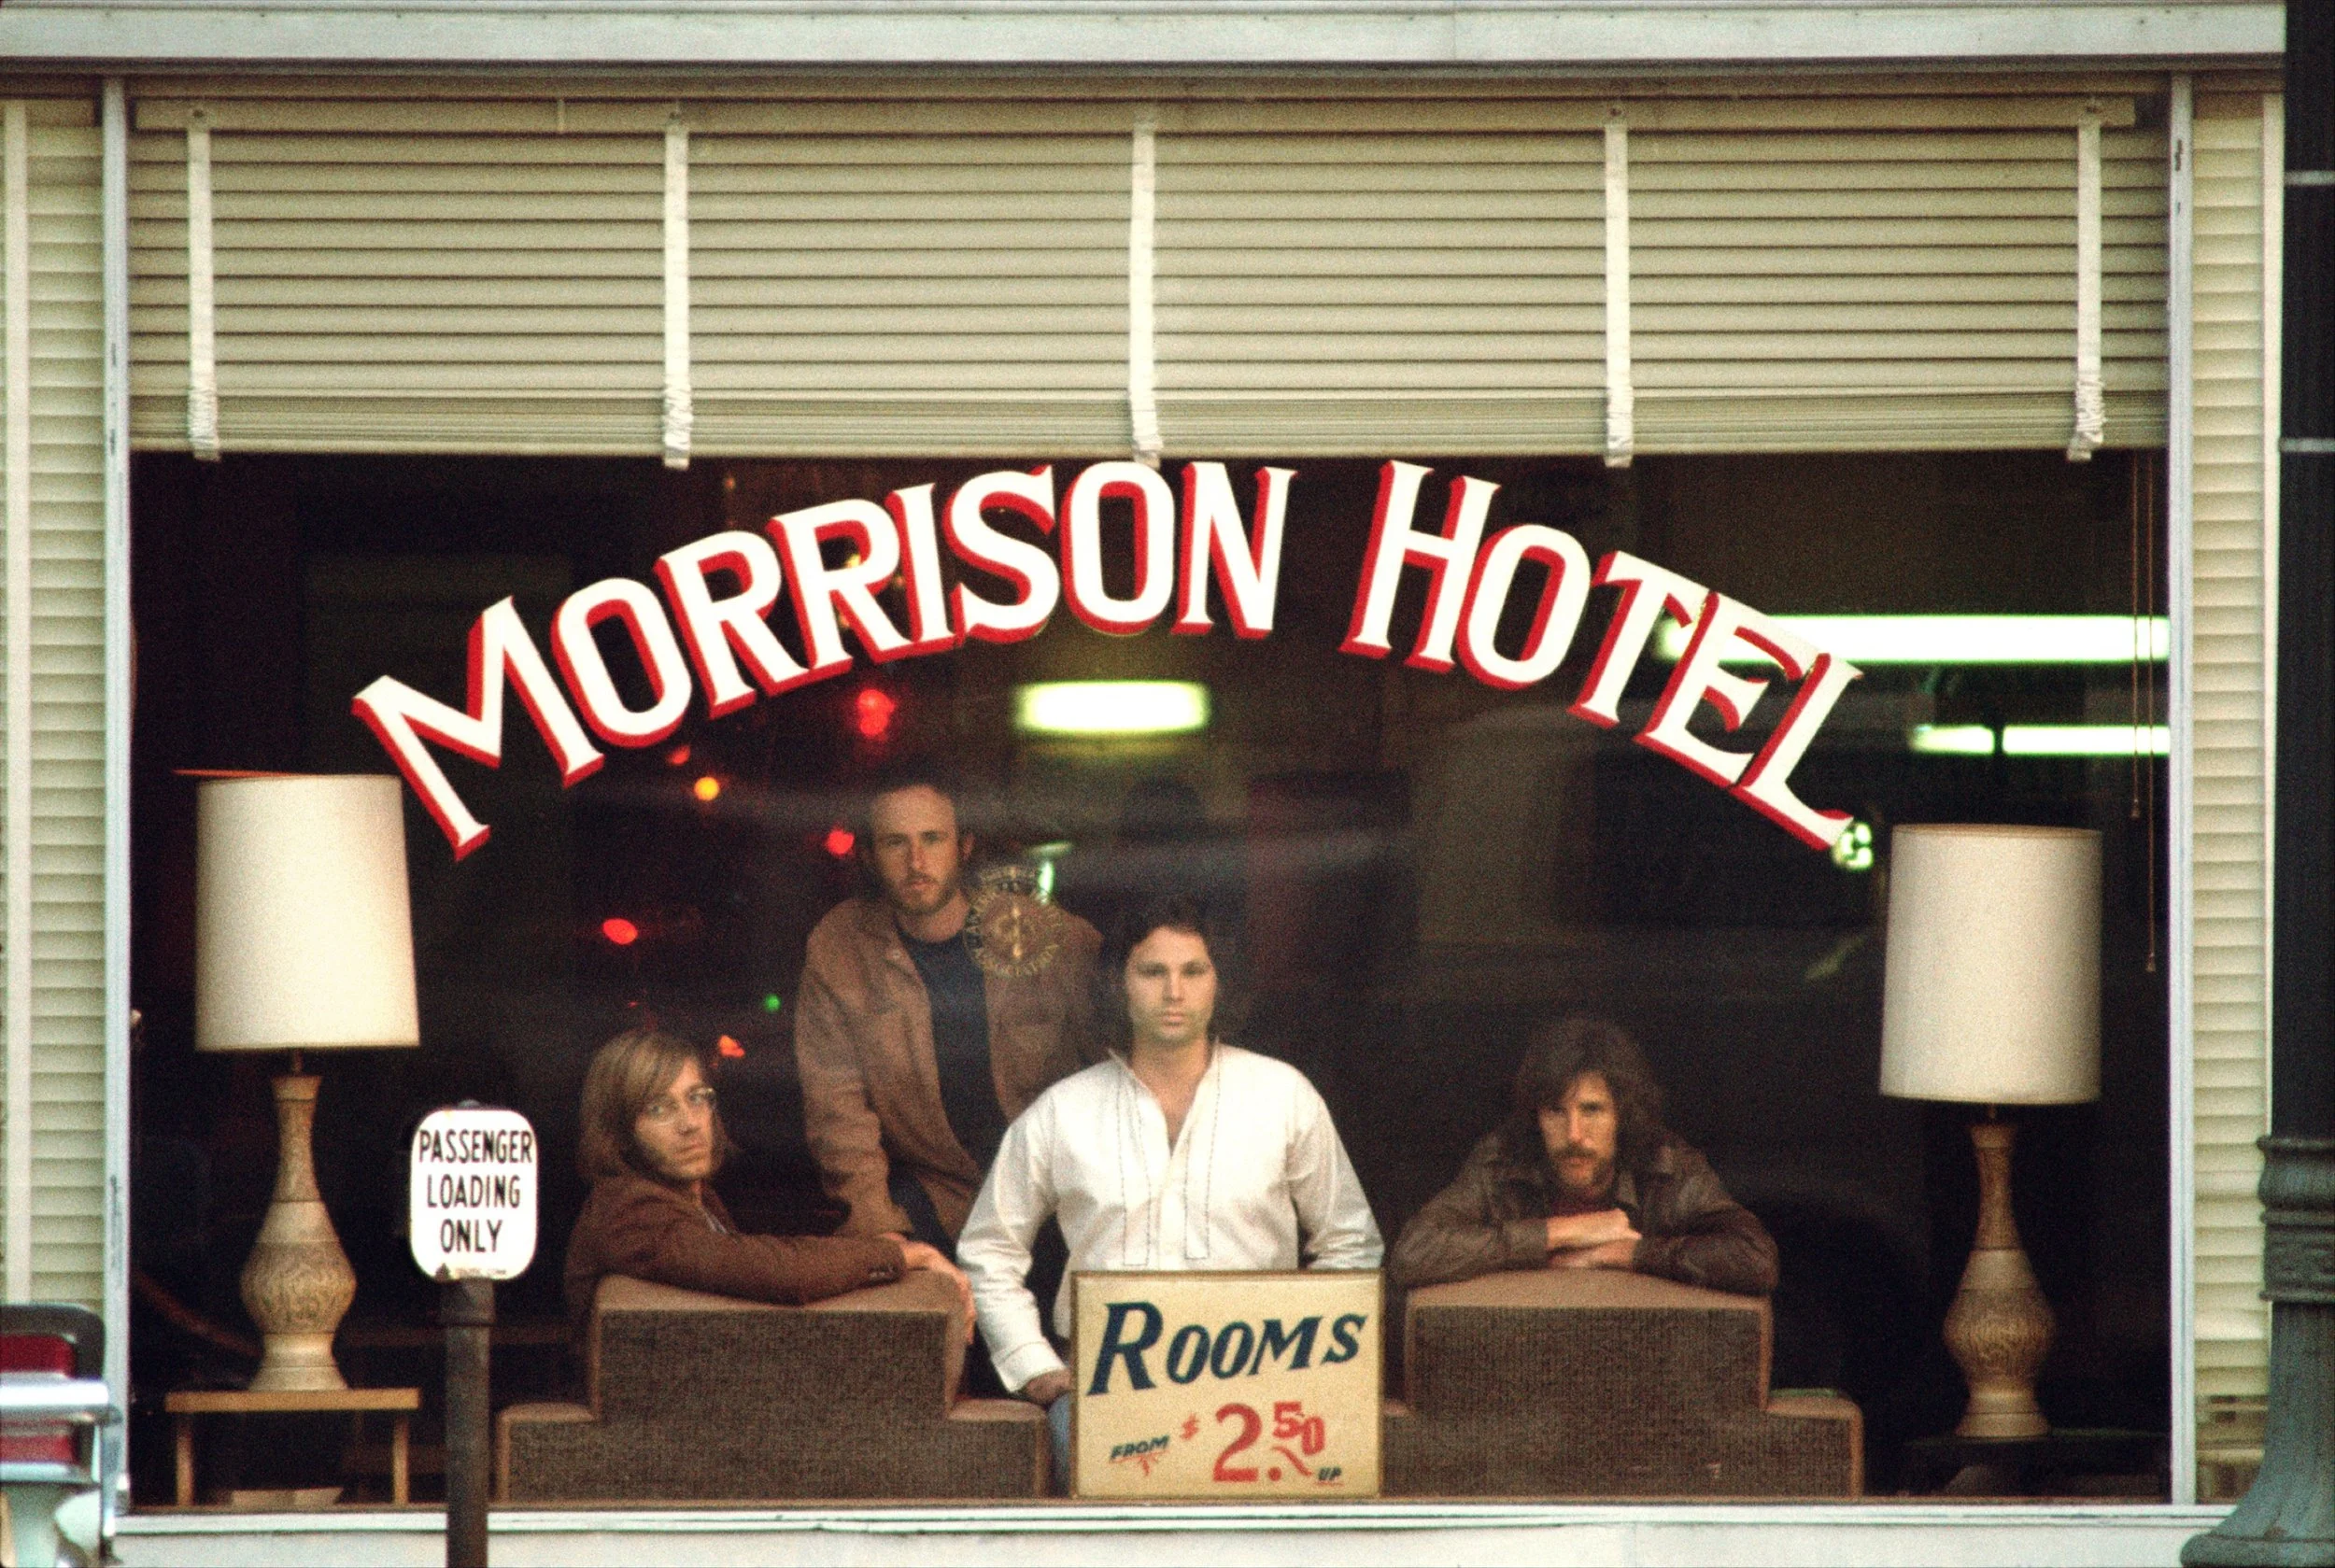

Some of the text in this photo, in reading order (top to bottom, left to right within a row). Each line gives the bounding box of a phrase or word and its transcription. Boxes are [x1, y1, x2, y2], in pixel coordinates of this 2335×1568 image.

[353, 459, 1863, 861] MORRISON HOTEL
[419, 1129, 532, 1164] PASSENGER
[427, 1174, 520, 1208] LOADING
[440, 1219, 502, 1253] ONLY
[1086, 1301, 1368, 1396] ROOMS
[1109, 1435, 1170, 1460] FROM
[1317, 1466, 1342, 1482] UP
